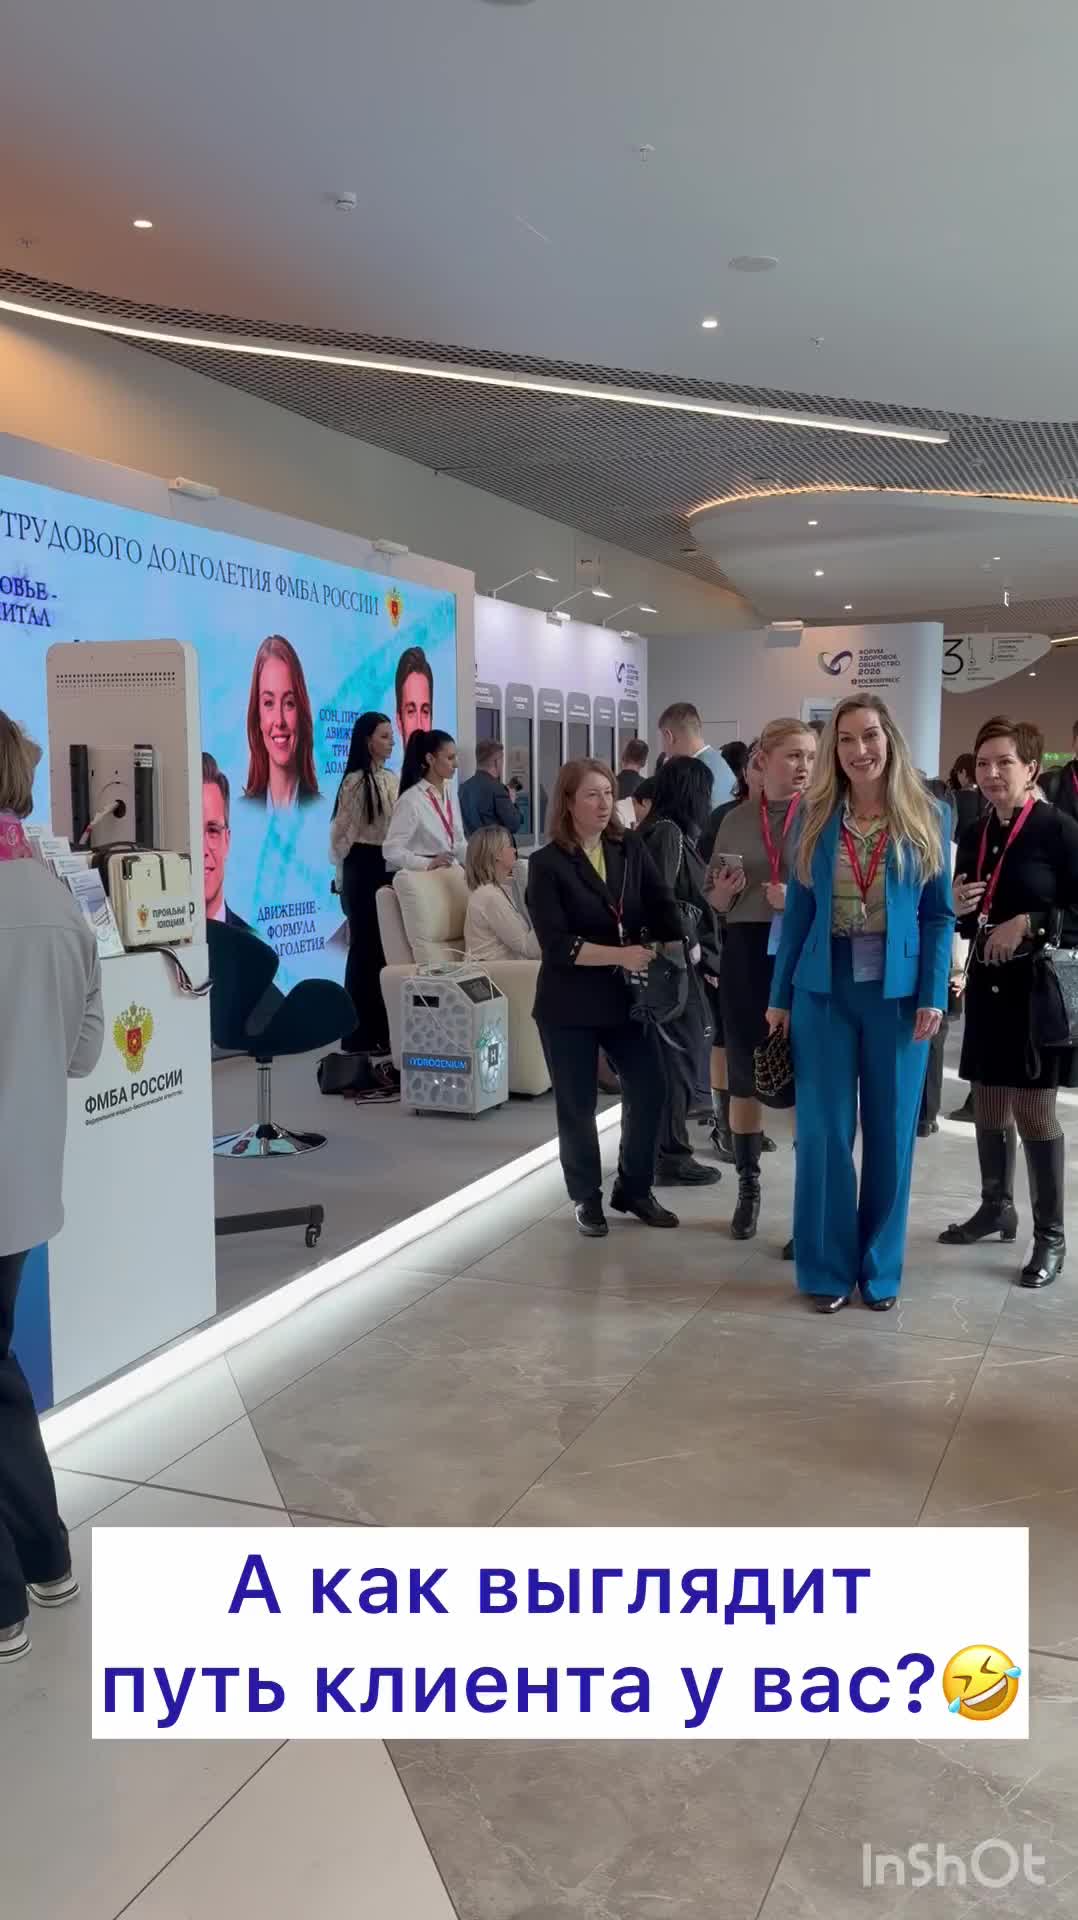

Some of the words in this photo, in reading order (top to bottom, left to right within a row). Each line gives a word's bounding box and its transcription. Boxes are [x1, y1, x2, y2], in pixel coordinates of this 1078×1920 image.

[0, 509, 142, 565] ТРУДОВОГО
[147, 543, 271, 593] ДОЛГОЛЕТИЯ
[275, 573, 320, 604] ФМБА
[322, 584, 379, 616] РОССИИ
[0, 602, 51, 627] ИТАЛ
[942, 638, 964, 675] 3
[325, 726, 352, 740] ДВИЖ
[267, 920, 316, 940] ФОРМУЛА
[273, 936, 325, 957] ЛГОЛЕТИЯ
[85, 1086, 128, 1114] ФМБА
[131, 1068, 183, 1100] РОССИИ
